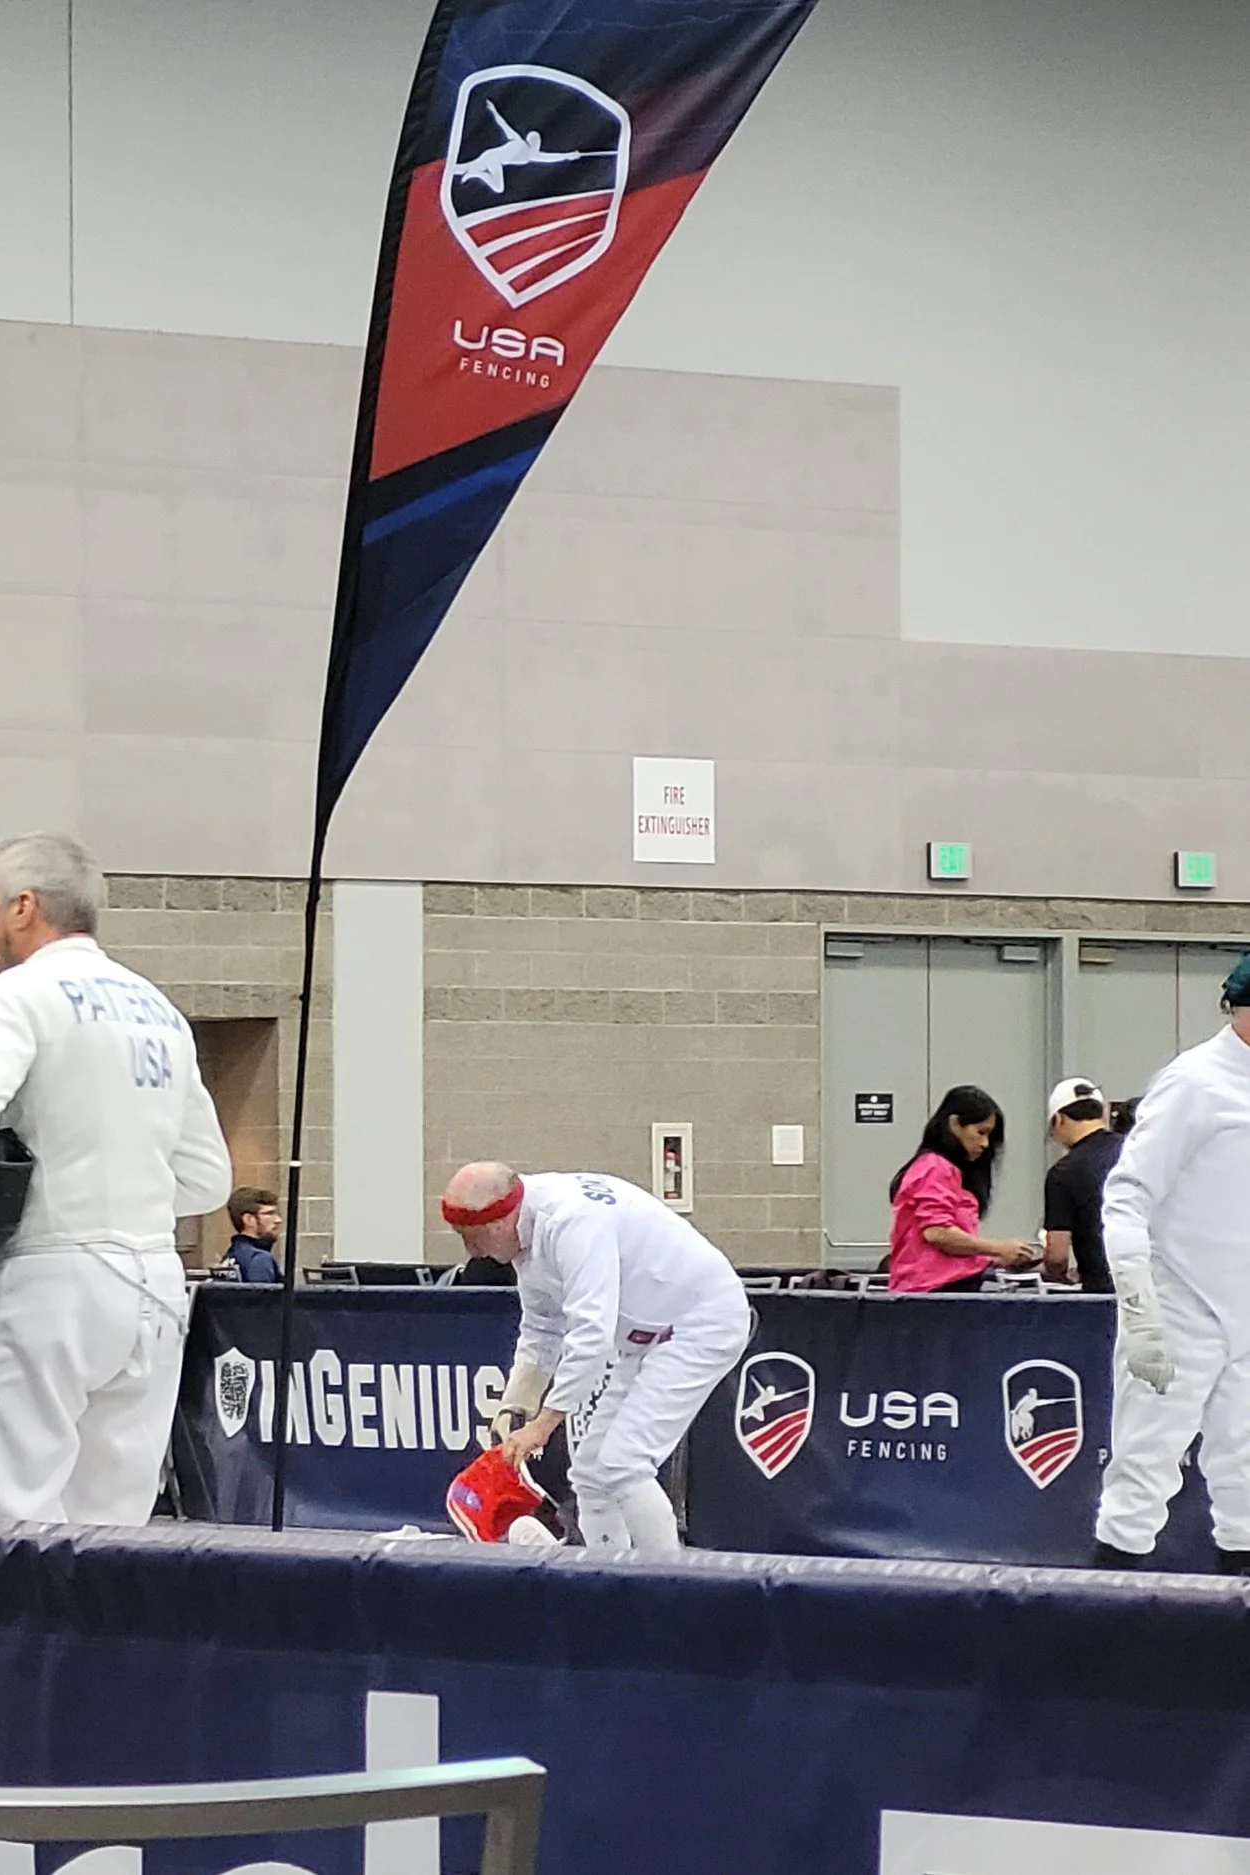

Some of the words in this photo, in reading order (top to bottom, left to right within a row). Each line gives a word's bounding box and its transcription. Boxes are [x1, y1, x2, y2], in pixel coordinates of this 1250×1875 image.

[453, 319, 565, 367] USA
[459, 357, 551, 389] FENCING
[664, 785, 685, 805] FIRE
[638, 814, 711, 836] EXTINGUISHER
[127, 1034, 173, 1089] USA
[839, 1390, 959, 1429] USA
[847, 1439, 948, 1461] FENCING
